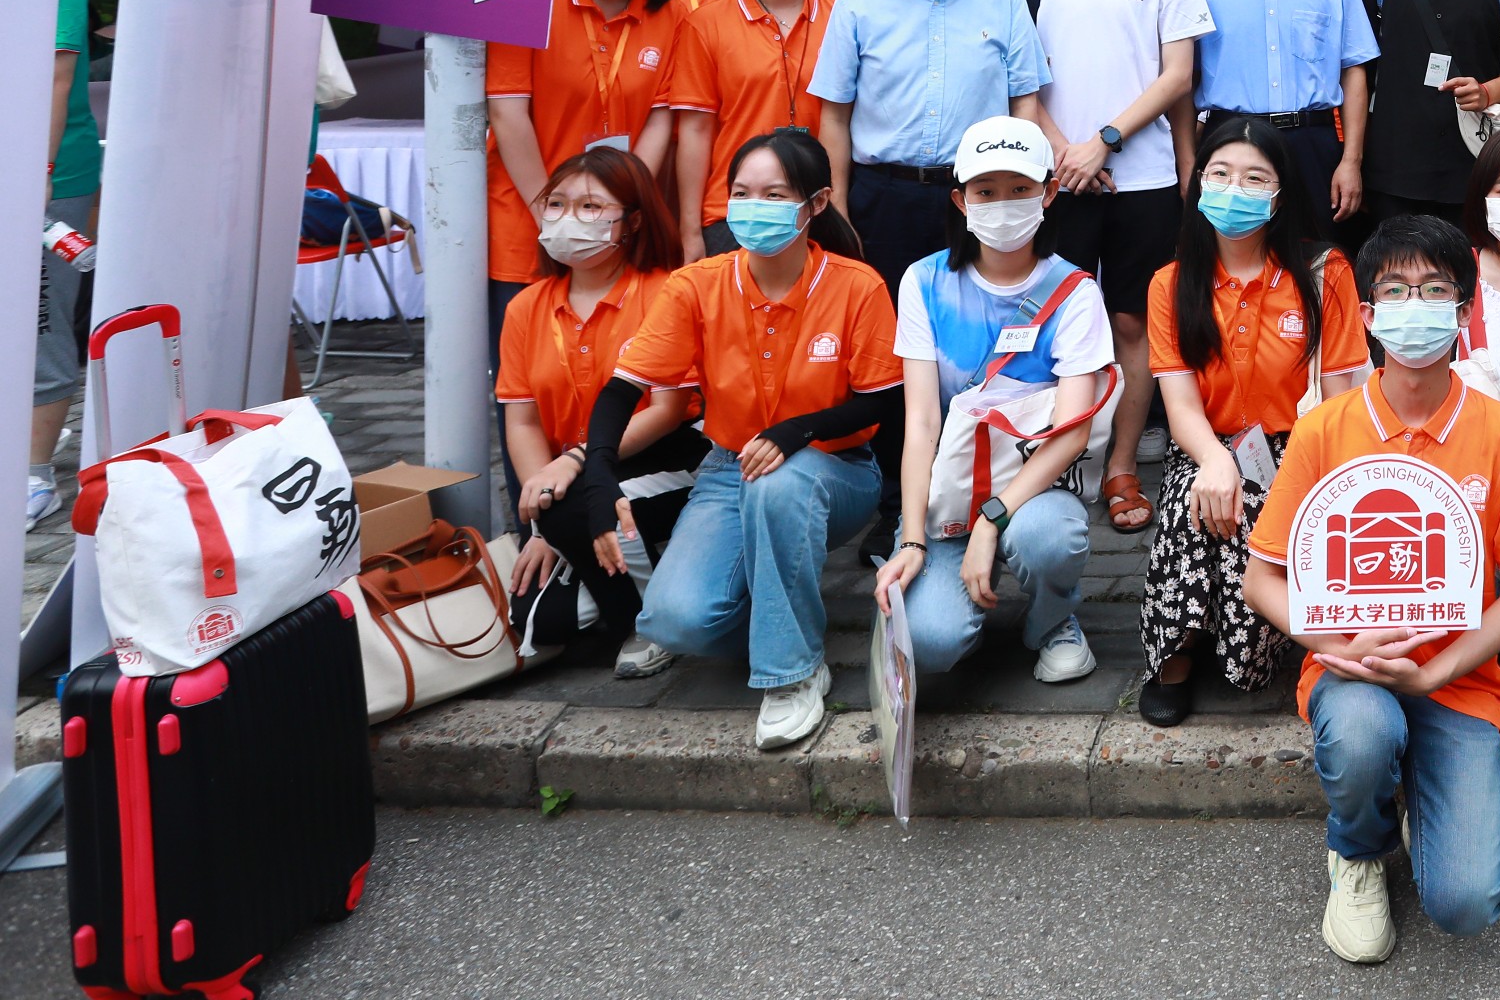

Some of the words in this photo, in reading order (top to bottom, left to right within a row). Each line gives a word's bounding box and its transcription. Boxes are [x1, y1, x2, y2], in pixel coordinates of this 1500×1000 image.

[1362, 466, 1435, 493] TSINGHUA
[1306, 474, 1359, 529] COLLEGE
[1434, 487, 1472, 570] UNIVERSITY
[1300, 531, 1315, 572] RIXIN
[1305, 601, 1467, 625] 清华大学日新书院
